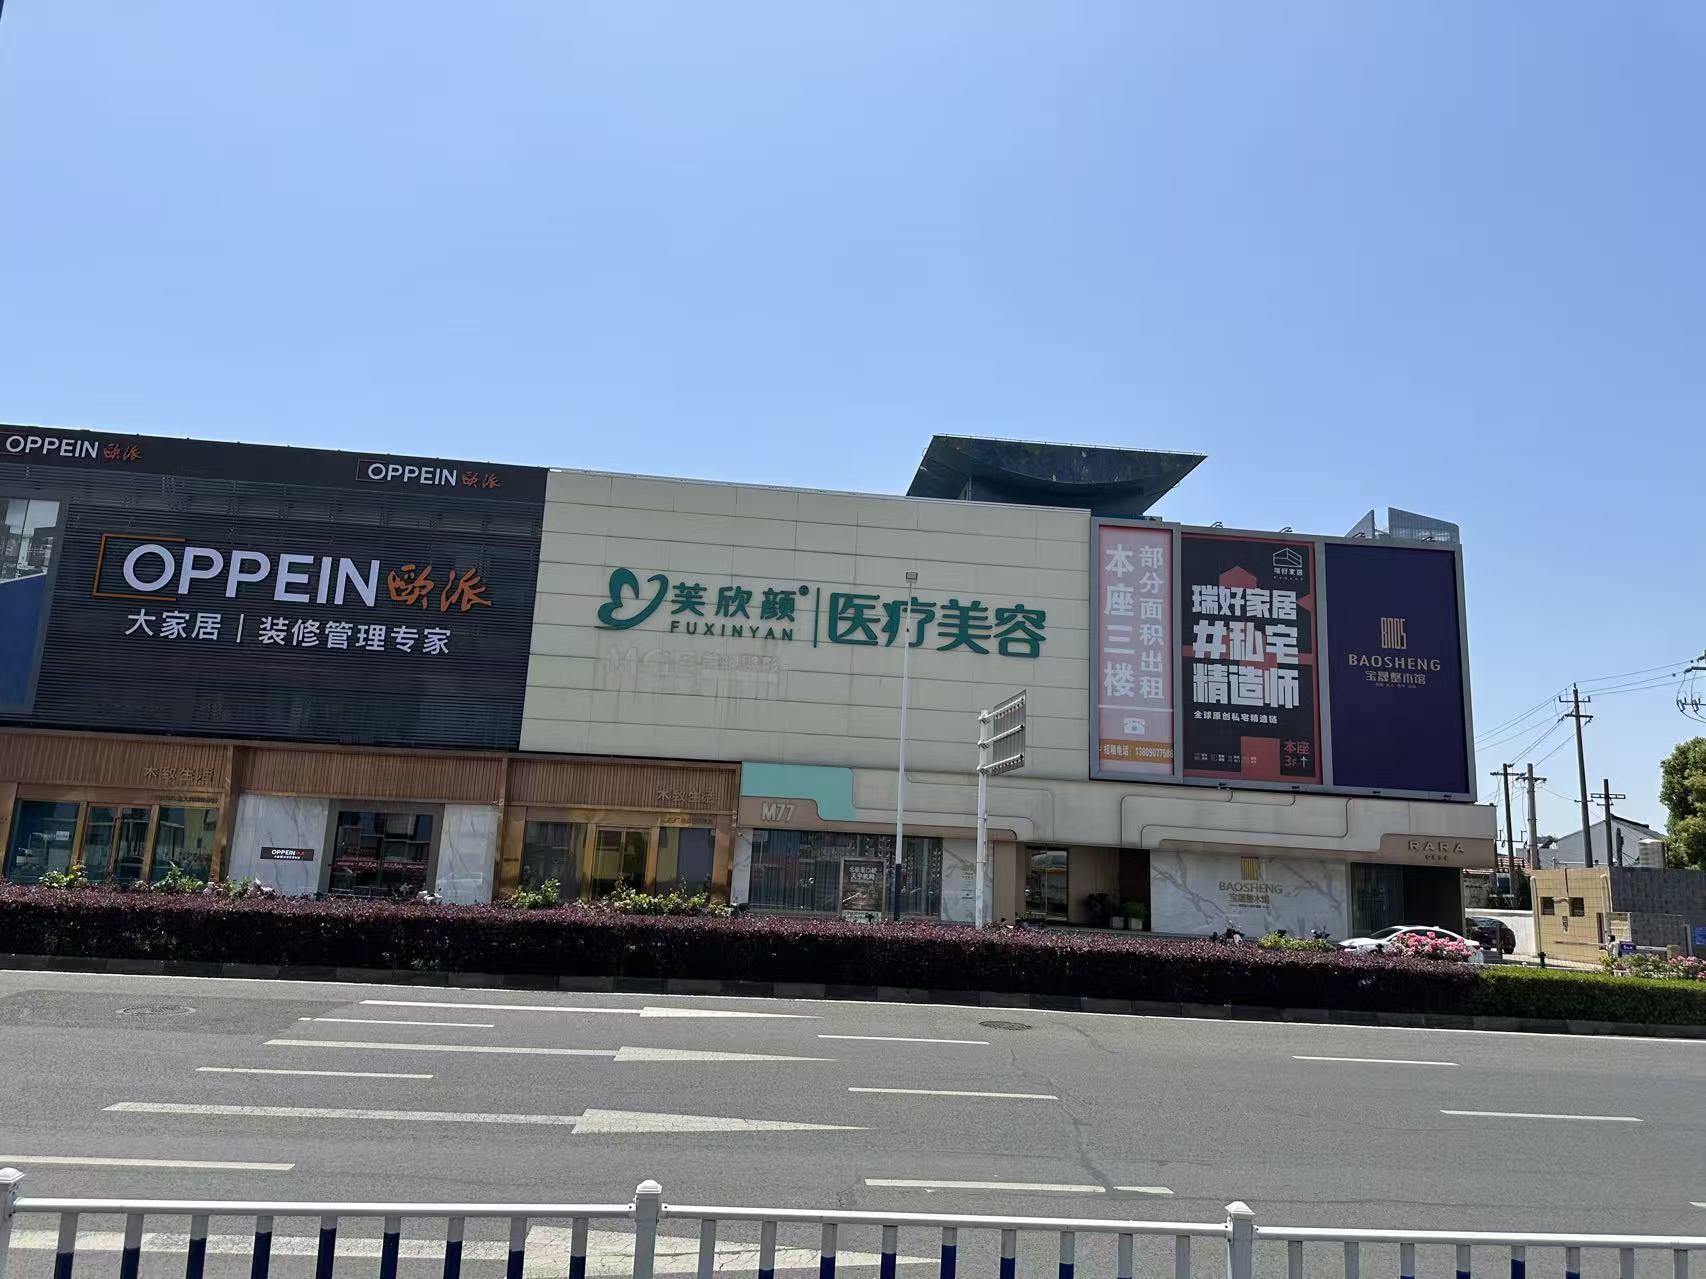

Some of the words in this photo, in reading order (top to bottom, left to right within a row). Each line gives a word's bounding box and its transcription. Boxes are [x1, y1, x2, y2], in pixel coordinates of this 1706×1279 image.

[5, 435, 99, 459] OPPEIN
[368, 463, 457, 486] OPPEIN
[122, 543, 381, 608] OPPEIN
[670, 581, 797, 623] 芙欣颜
[1192, 585, 1297, 620] 瑞好家居
[124, 608, 222, 641] 大家居
[257, 616, 452, 656] 装修管理专家
[670, 620, 794, 642] FUXINYAN
[828, 592, 1047, 659] 医疗美容
[1103, 543, 1136, 698] 本座三楼
[1139, 546, 1165, 700] 部分面积出租
[1348, 653, 1441, 671] BAOSHENG
[1193, 663, 1300, 709] 精造师
[1284, 740, 1311, 755] 本座
[761, 801, 796, 821] M77
[1408, 840, 1465, 854] RARA
[1218, 880, 1284, 895] BAOSHENG
